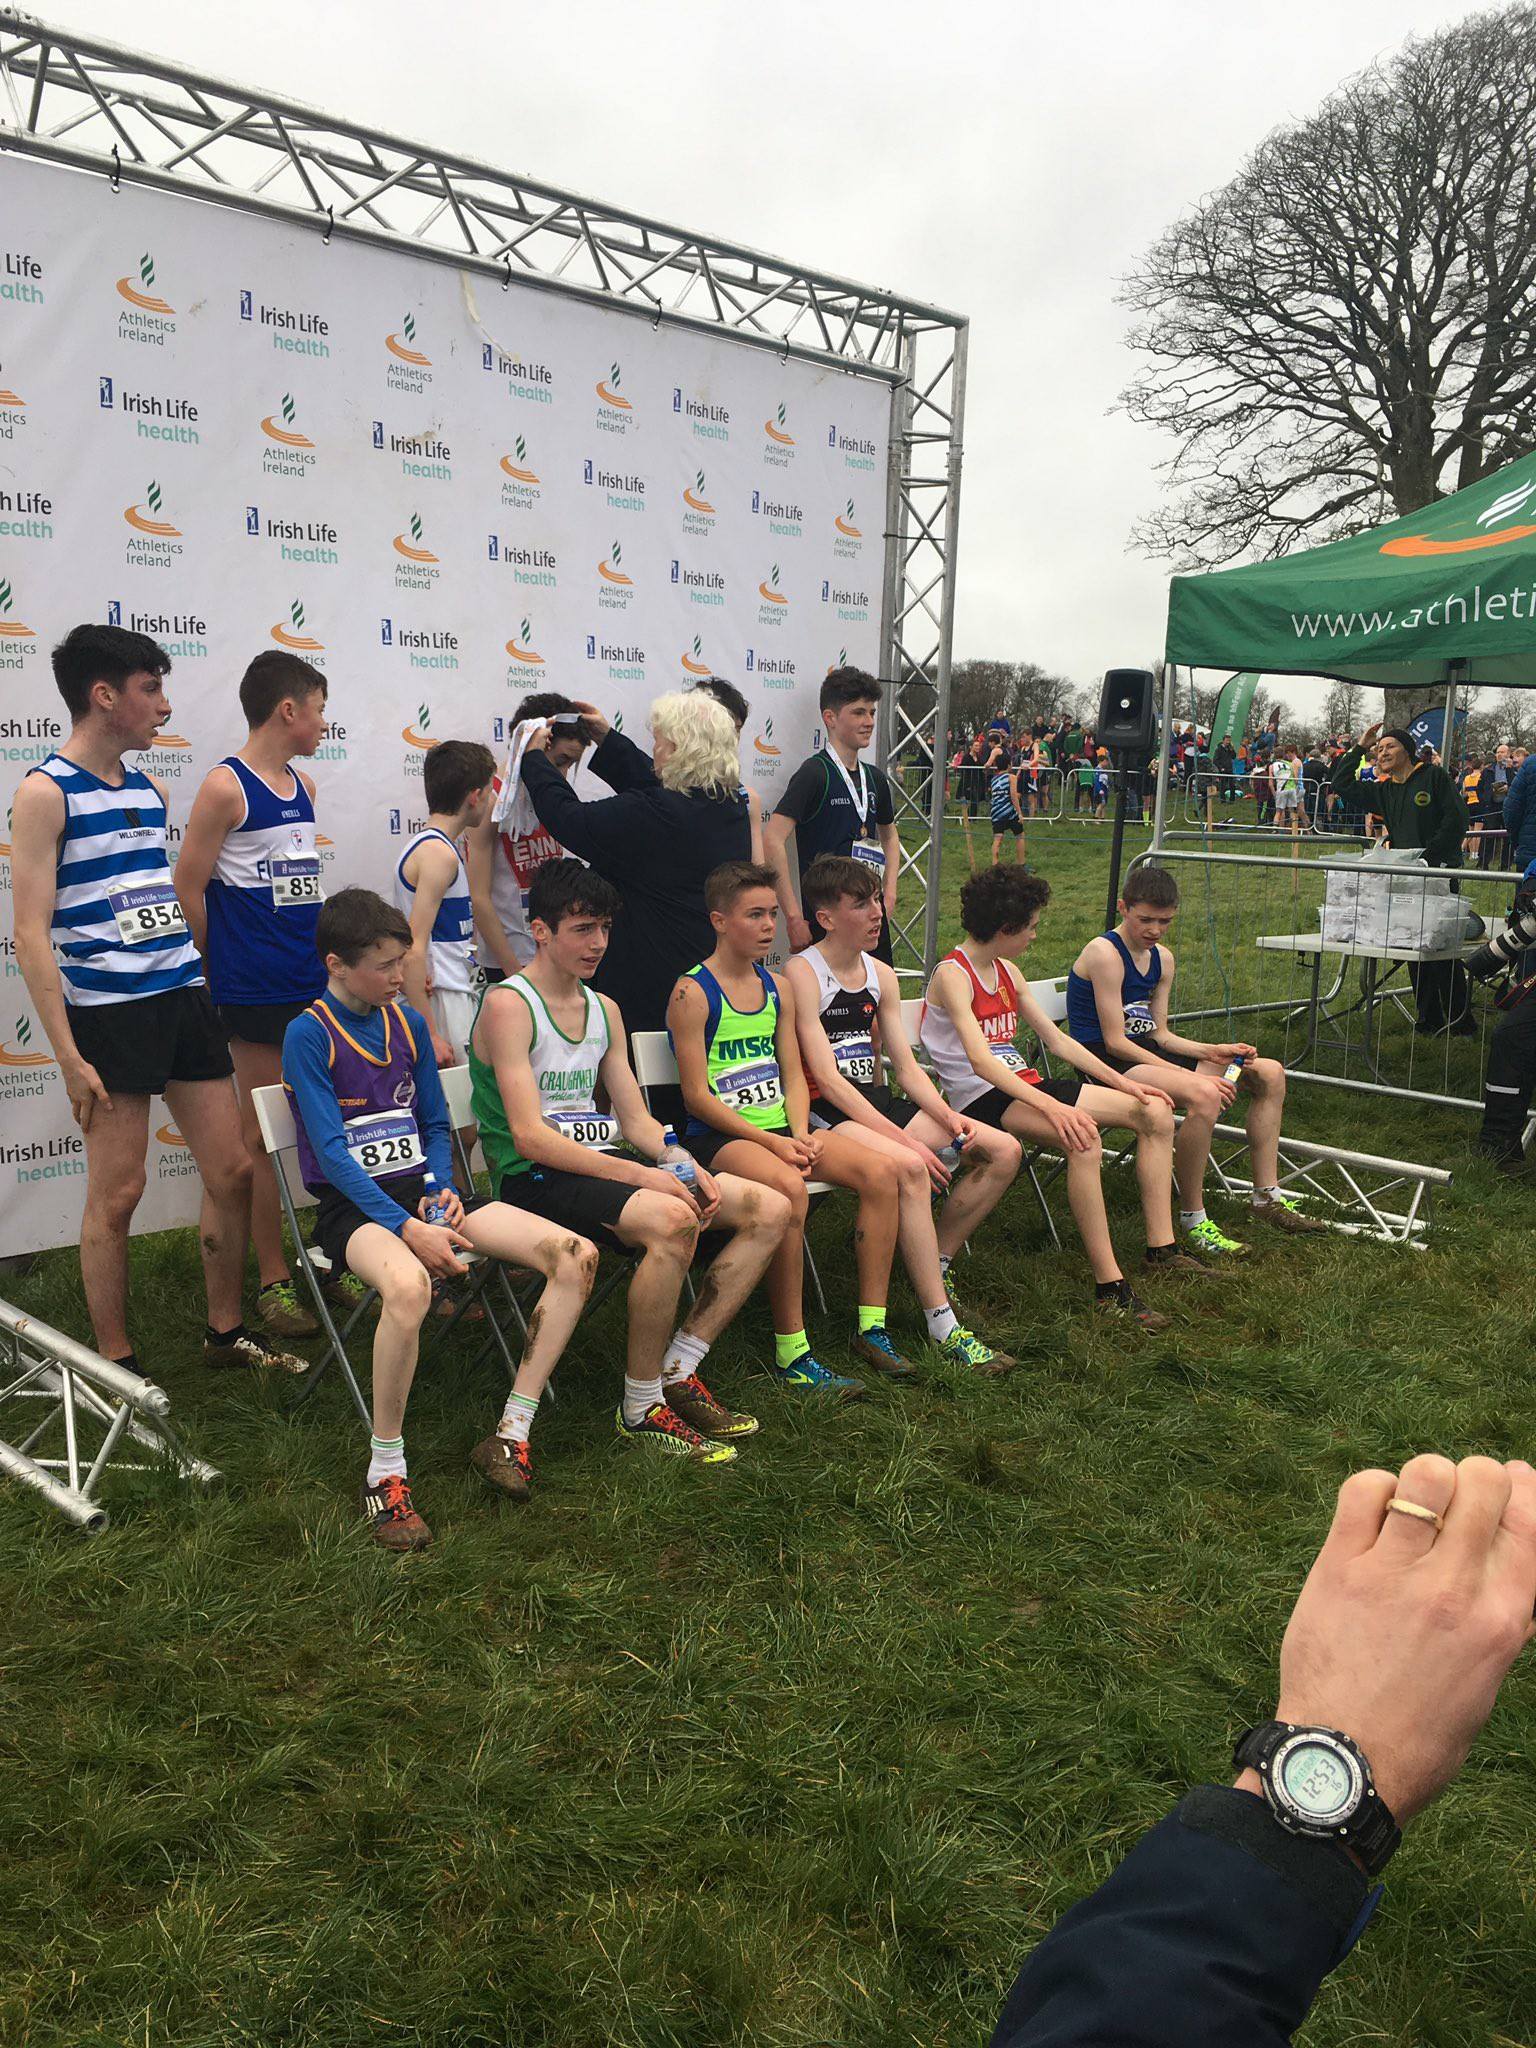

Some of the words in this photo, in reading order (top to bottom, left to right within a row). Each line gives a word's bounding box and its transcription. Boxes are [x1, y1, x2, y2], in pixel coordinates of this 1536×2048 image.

[6, 253, 42, 279] Life
[0, 282, 44, 304] alth
[118, 311, 176, 333] Athletics
[260, 305, 296, 330] Irish
[300, 313, 329, 335] Life
[118, 326, 164, 346] Ireland
[273, 333, 330, 358] health
[387, 364, 433, 383] Athletics
[498, 356, 527, 380] Irish
[529, 364, 552, 384] Life
[386, 376, 424, 394] Ireland
[508, 381, 552, 404] health
[123, 392, 162, 417] Irish
[166, 398, 198, 421] Life
[685, 399, 708, 419] Irish
[711, 406, 729, 424] Life
[597, 407, 633, 425] Athletics
[137, 420, 199, 445] health
[596, 419, 625, 435] Ireland
[693, 421, 729, 442] health
[390, 434, 422, 457] Irish
[425, 441, 451, 461] Life
[764, 443, 795, 459] Athletics
[838, 435, 858, 453] Irish
[859, 440, 876, 456] Life
[263, 447, 316, 465] Athletics
[763, 455, 788, 468] Ireland
[845, 453, 875, 472] health
[262, 461, 305, 478] Ireland
[402, 459, 451, 481] health
[501, 483, 541, 499] Athletics
[597, 471, 623, 490] Irish
[625, 476, 645, 494] Life
[17, 493, 52, 515] Life
[501, 494, 533, 510] Ireland
[606, 493, 645, 512] health
[763, 501, 783, 519] Irish
[785, 505, 803, 521] Life
[0, 519, 53, 539] ealth
[683, 512, 715, 528] Athletics
[769, 520, 802, 537] health
[267, 519, 304, 541] Irish
[307, 523, 337, 543] Life
[682, 523, 708, 537] Ireland
[126, 538, 183, 554] Athletics
[833, 547, 856, 559] Ireland
[834, 537, 862, 551] Athletics
[126, 552, 171, 568] Ireland
[281, 544, 339, 565] health
[504, 546, 531, 566] Irish
[533, 550, 556, 569] Life
[395, 563, 440, 578] Athletics
[513, 569, 557, 588] health
[683, 569, 705, 588] Irish
[706, 574, 725, 590] Life
[394, 576, 431, 590] Ireland
[599, 585, 634, 600] Athletics
[690, 589, 724, 607] health
[831, 589, 851, 605] Irish
[852, 593, 869, 607] Life
[598, 597, 626, 610] Ireland
[759, 604, 788, 617] Athletics
[1291, 583, 1536, 638] www.athleti
[758, 614, 782, 626] Ireland
[838, 607, 868, 622] health
[131, 613, 170, 634] Irish
[174, 616, 206, 636] Life
[0, 641, 36, 654] letics
[159, 640, 208, 657] ealth
[399, 630, 429, 649] Irish
[432, 632, 459, 650] Life
[410, 652, 459, 669] health
[600, 645, 624, 662] Irish
[626, 647, 645, 663] Life
[507, 666, 546, 678] Athletics
[608, 665, 645, 681] health
[757, 658, 777, 673] Irish
[777, 661, 796, 675] Life
[506, 677, 537, 689] Ireland
[763, 676, 795, 690] health
[27, 718, 61, 738] Life
[324, 722, 347, 740] ife
[136, 751, 193, 764] Athletics
[303, 744, 347, 760] alth
[141, 765, 181, 777] eland
[404, 765, 425, 777] Irela
[752, 766, 775, 777] Ireland
[753, 758, 781, 768] Athletics
[407, 818, 428, 834] Iris
[130, 896, 147, 905] Irish
[146, 894, 158, 903] Life
[137, 903, 185, 930] 854
[765, 953, 781, 966] Life
[718, 1036, 773, 1060] MSB
[849, 1058, 874, 1077] 858
[733, 1078, 746, 1087] Irish
[745, 1075, 757, 1083] Life
[0, 1083, 44, 1099] reland
[737, 1080, 776, 1105] 815
[356, 1129, 374, 1142] Irish
[373, 1127, 387, 1138] Life
[573, 1121, 610, 1142] 800
[0, 1142, 44, 1164] Irish
[48, 1135, 83, 1157] Life
[159, 1151, 193, 1165] Athle
[361, 1137, 413, 1167] 828
[17, 1160, 86, 1183] health
[159, 1163, 200, 1178] Irelan
[1302, 1758, 1337, 1800] 12:53
